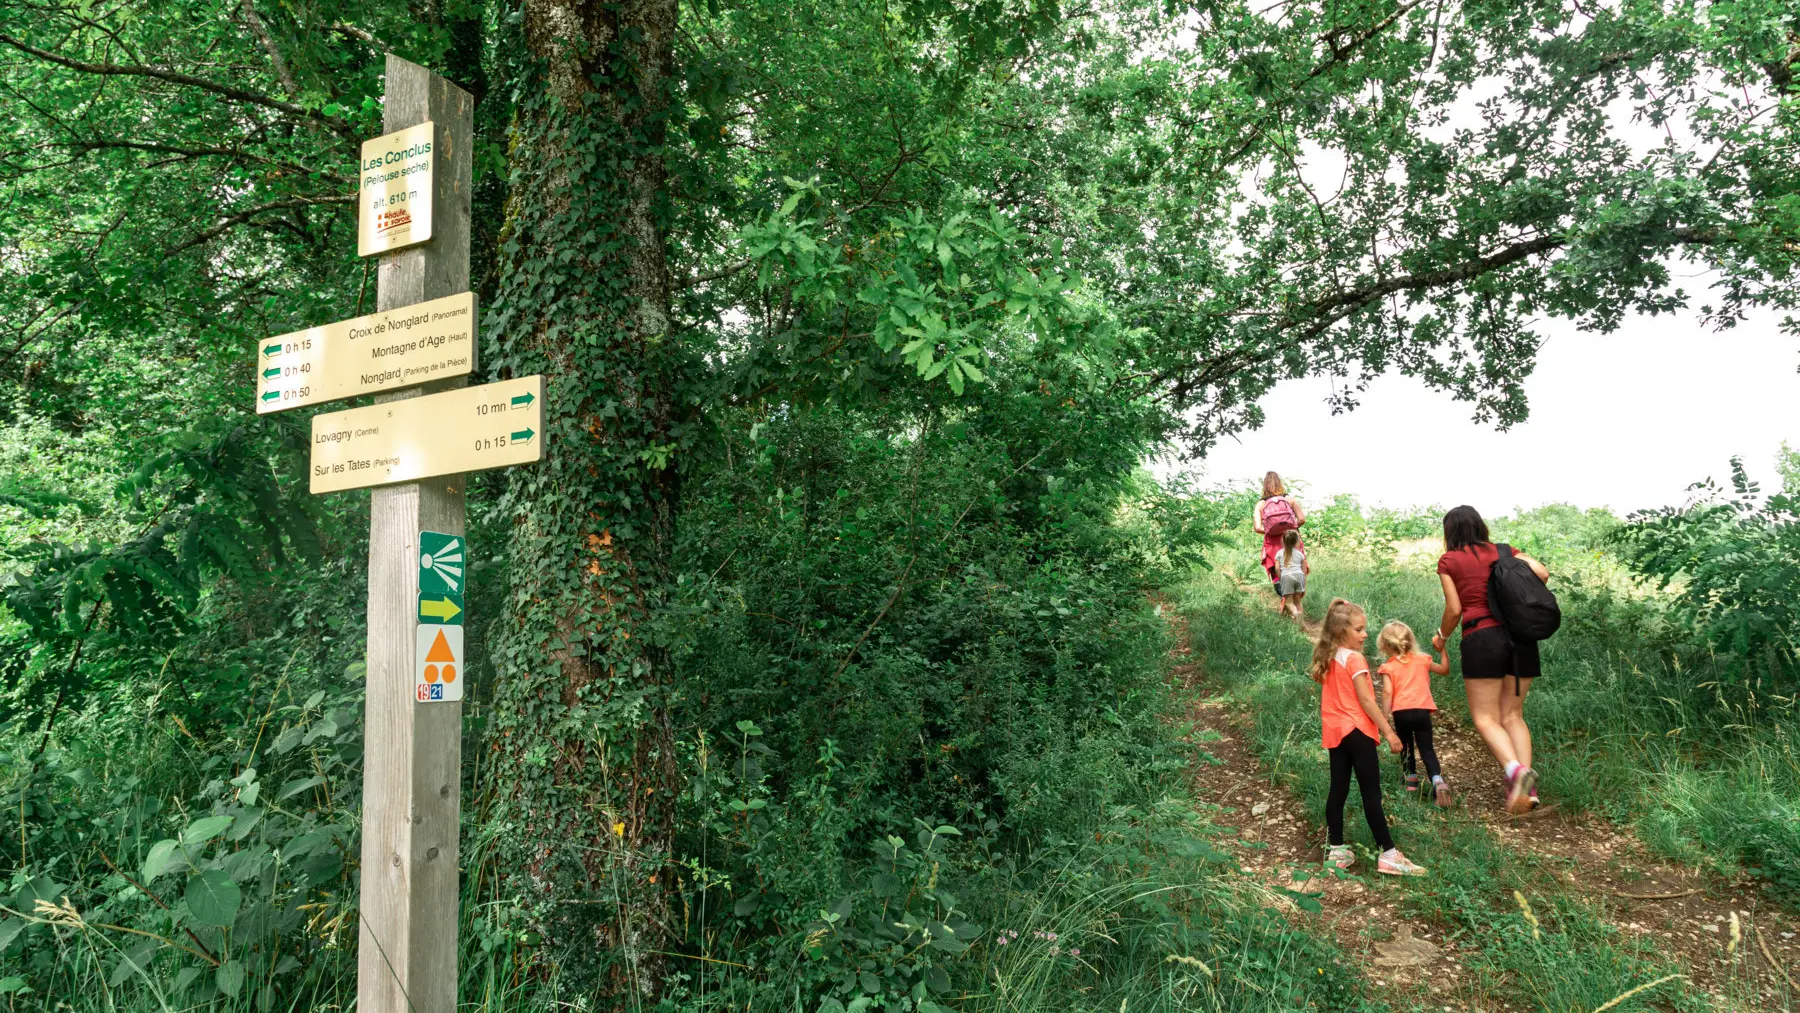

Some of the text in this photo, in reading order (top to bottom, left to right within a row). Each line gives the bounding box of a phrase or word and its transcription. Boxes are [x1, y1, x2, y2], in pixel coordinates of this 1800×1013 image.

[363, 142, 432, 172] Les Conclus
[364, 170, 400, 190] (Pelouse
[374, 190, 418, 209] alt. 610 m
[349, 306, 468, 340] Croix de Nonglard (Panorama)
[285, 340, 312, 354] 0 h 15
[372, 332, 468, 359] Montagne d'Age (Haut)
[284, 362, 310, 376] 0 h 40
[360, 368, 401, 386] Nonglard
[403, 365, 429, 378] (Parking
[431, 362, 439, 371] de
[440, 360, 447, 369] la
[284, 386, 310, 400] 0 h 50
[476, 402, 506, 416] 10 mn
[316, 426, 379, 444] Lovagny (Centre)
[475, 436, 506, 451] 0 h 15
[314, 456, 400, 477] Sur les Tates (Parking)
[419, 685, 442, 700] 19 21
